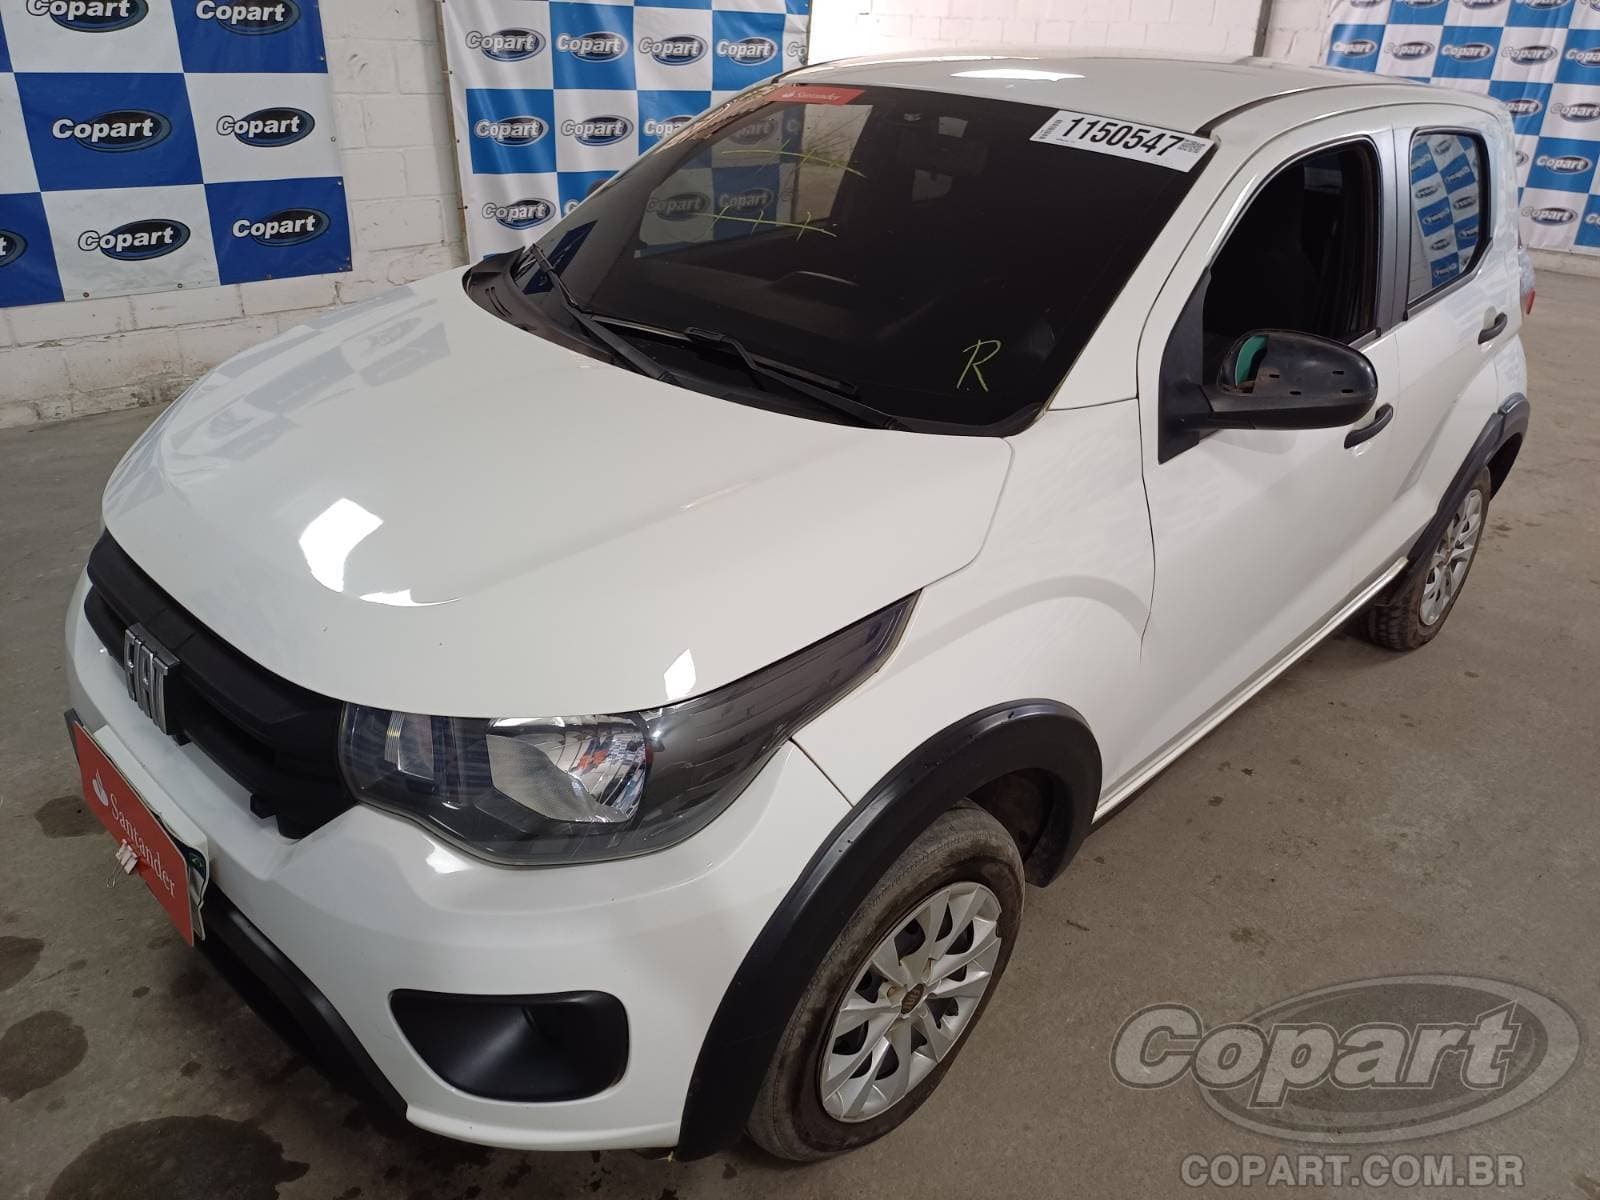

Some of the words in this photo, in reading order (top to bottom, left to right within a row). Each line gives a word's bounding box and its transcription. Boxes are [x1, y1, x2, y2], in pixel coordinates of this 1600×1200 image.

[196, 0, 285, 25] Copart
[466, 31, 535, 53] Copart
[557, 33, 621, 56] Copart
[639, 36, 700, 59] Copart
[717, 39, 771, 58] Copart
[1441, 44, 1489, 59] Copart
[1566, 48, 1600, 62] Copa
[52, 118, 154, 143] Copart
[216, 115, 300, 138] Copart
[475, 119, 539, 141] Copart
[560, 118, 626, 140] Copart
[1062, 117, 1185, 157] 1150547
[1536, 155, 1585, 170] Copart
[719, 190, 769, 210] Copart
[482, 201, 546, 224] Copart
[1521, 207, 1571, 221] Copart
[232, 214, 316, 239] Copart
[78, 226, 175, 252] Copart
[956, 338, 1002, 392] R
[110, 792, 176, 899] Santander
